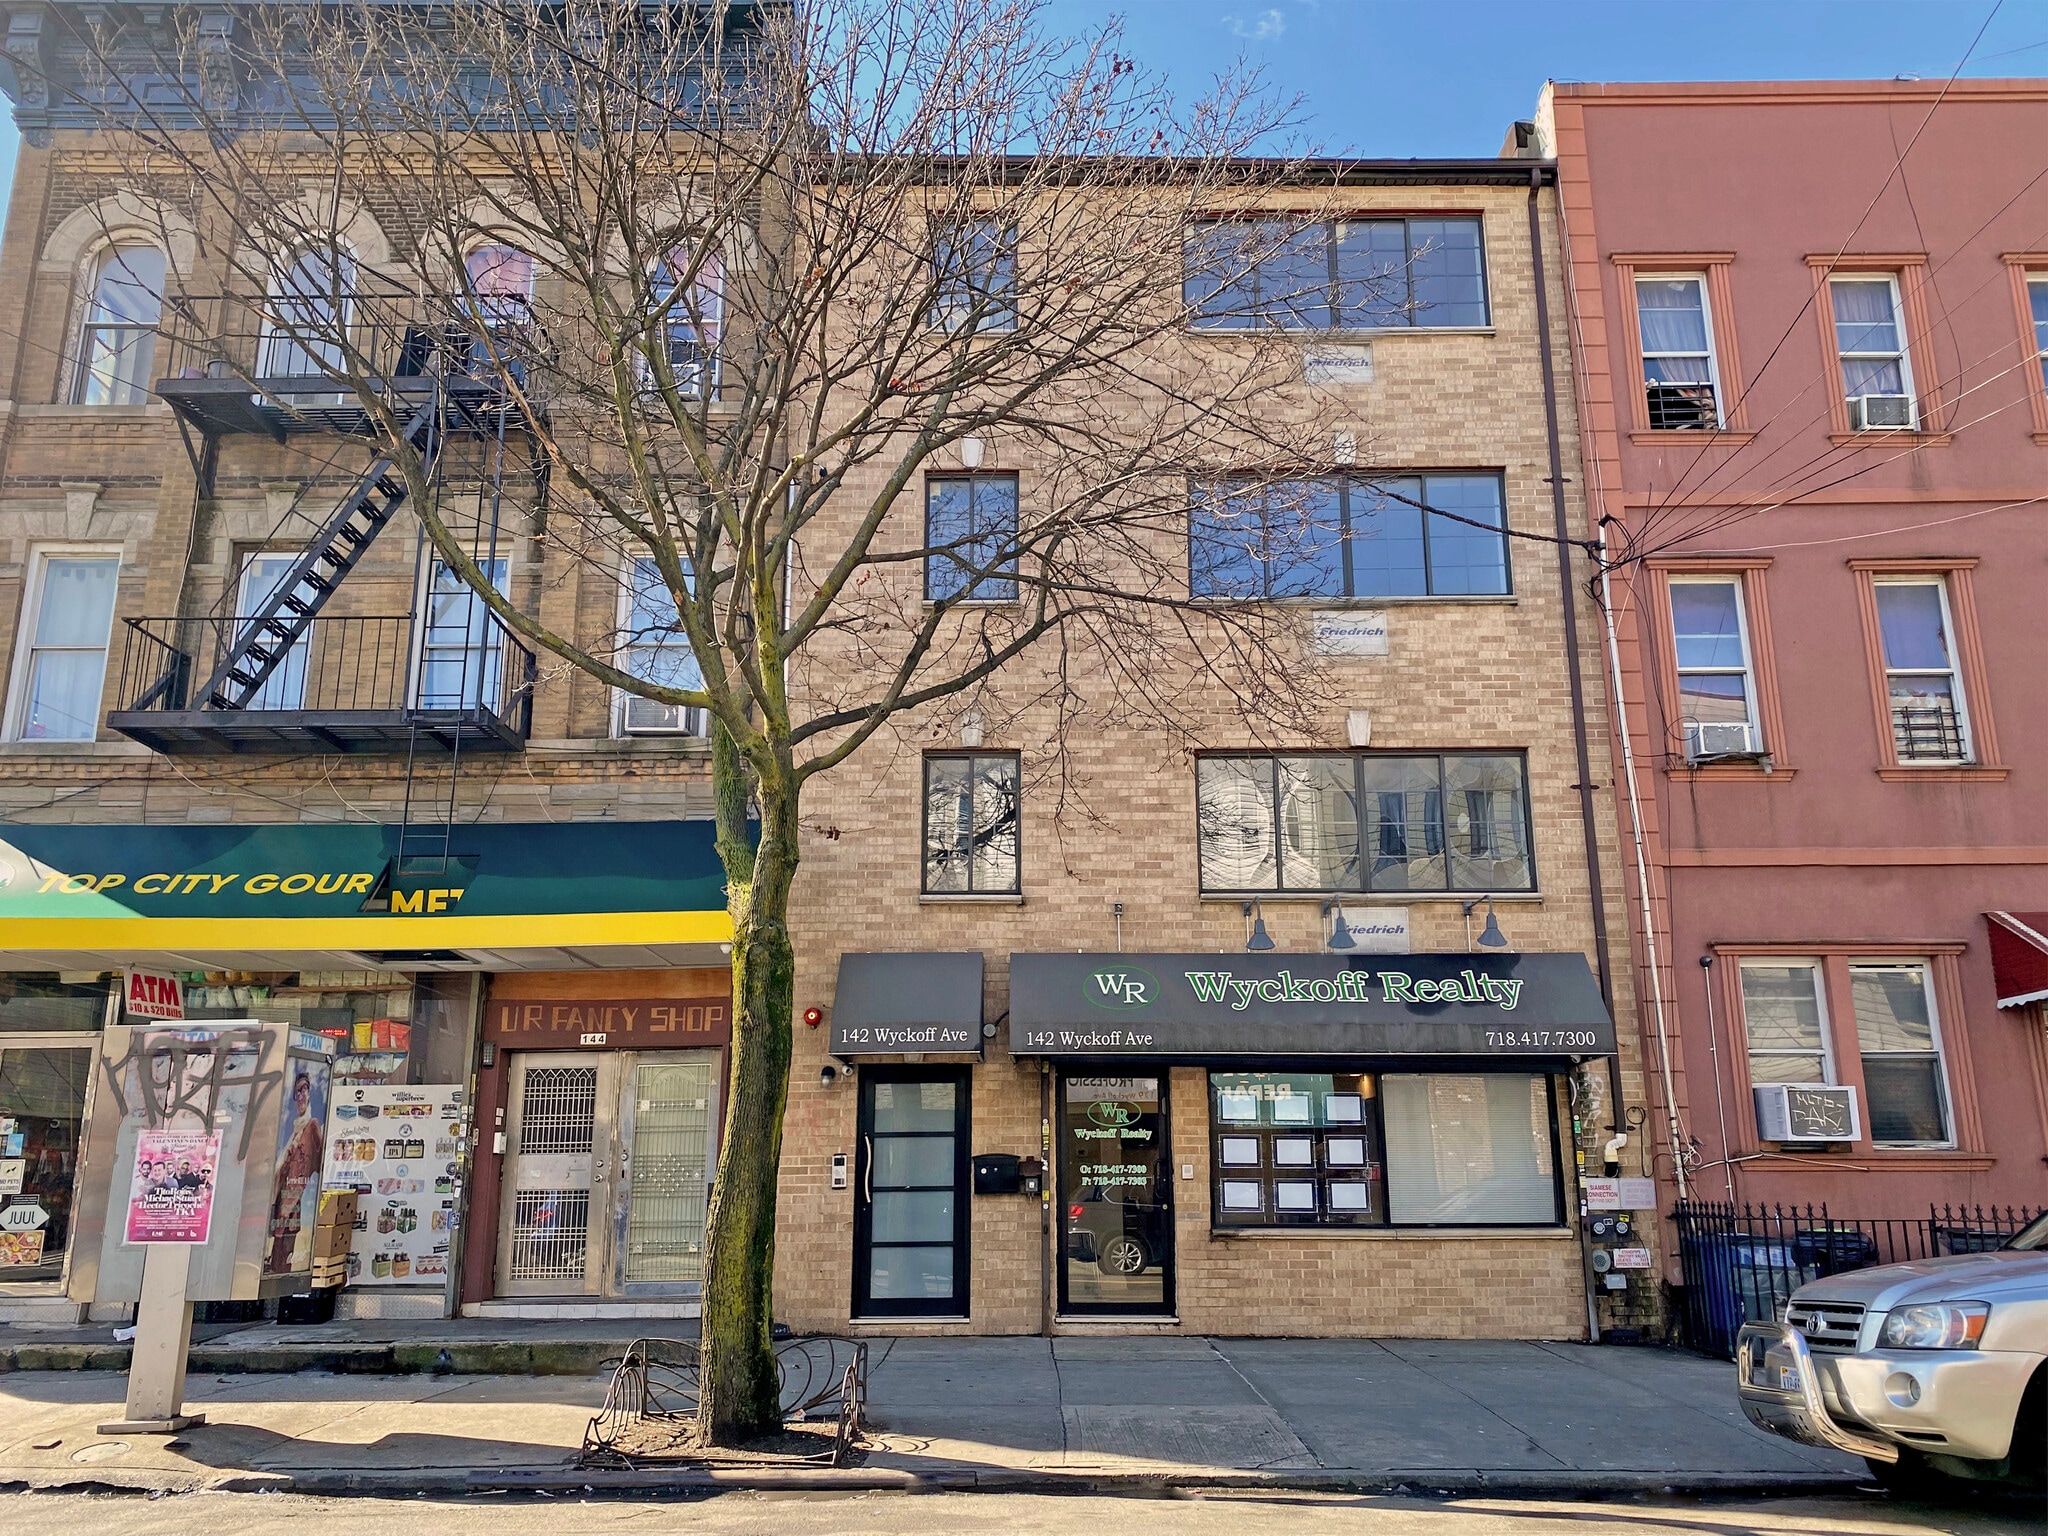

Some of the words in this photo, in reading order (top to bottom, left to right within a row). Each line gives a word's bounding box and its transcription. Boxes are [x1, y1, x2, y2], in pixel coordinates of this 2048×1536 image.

[1320, 627, 1384, 636] Friedrich
[37, 873, 127, 894] TOP
[133, 873, 240, 894] CITY
[243, 873, 375, 894] GOUR
[130, 973, 180, 1007] ATM
[1094, 974, 1148, 1004] WR
[1185, 969, 1370, 1010] Wyckoff
[1376, 969, 1524, 1011] Realty
[129, 1003, 143, 1012] $10
[150, 1005, 165, 1016] $20
[551, 1007, 638, 1033] FANCY
[651, 1006, 724, 1032] SHOP
[300, 1034, 323, 1050] TITAN
[582, 1034, 605, 1044] 144
[841, 1028, 869, 1043] 142
[874, 1027, 937, 1047] Wyckoff
[941, 1028, 968, 1042] Ave
[1026, 1031, 1054, 1046] 142
[1059, 1030, 1121, 1050] Wyckoff
[1124, 1032, 1153, 1046] Ave
[1485, 1031, 1597, 1047] 718.417.7300
[1099, 1102, 1130, 1123] WR
[1074, 1128, 1117, 1140] Wyckoff
[1120, 1128, 1152, 1140] Realty
[8, 1211, 35, 1225] JUUL
[175, 1208, 195, 1216] TKA
